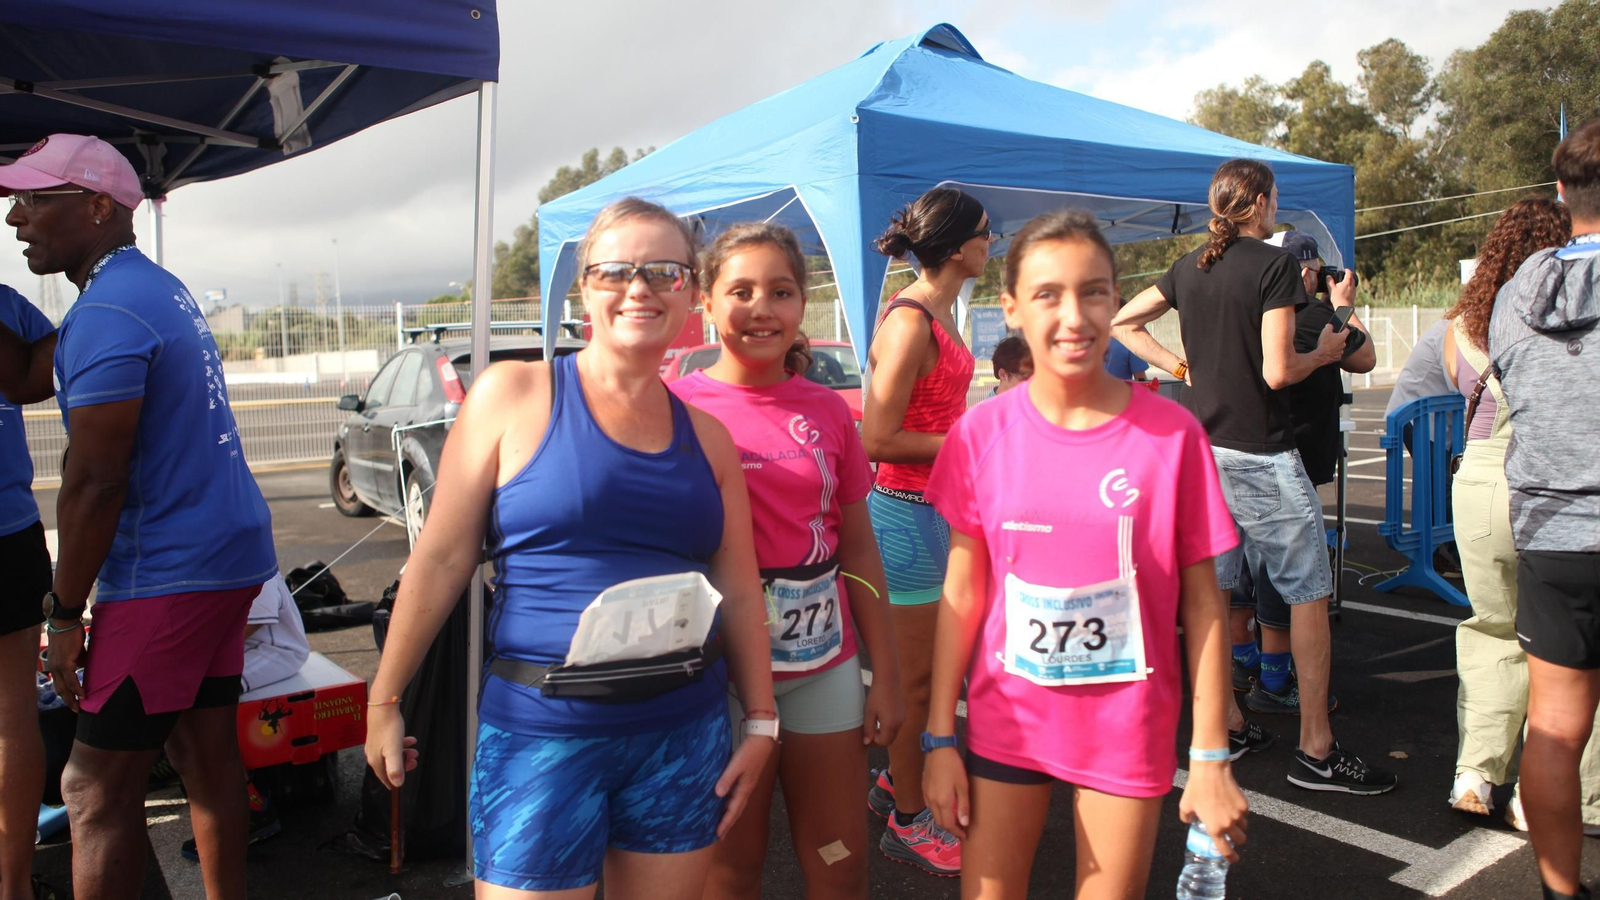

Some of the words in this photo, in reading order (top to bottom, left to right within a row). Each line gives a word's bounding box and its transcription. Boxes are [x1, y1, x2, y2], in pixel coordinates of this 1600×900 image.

[741, 449, 808, 462] ACULADA
[777, 586, 801, 600] CROSS
[1043, 596, 1092, 610] INCLUSIVO
[780, 597, 834, 641] 272
[796, 635, 826, 648] LORETO
[1028, 617, 1107, 654] 273
[1043, 654, 1092, 665] LOURDES
[313, 696, 353, 710] ANDANTE
[313, 704, 361, 720] CABALLERO
